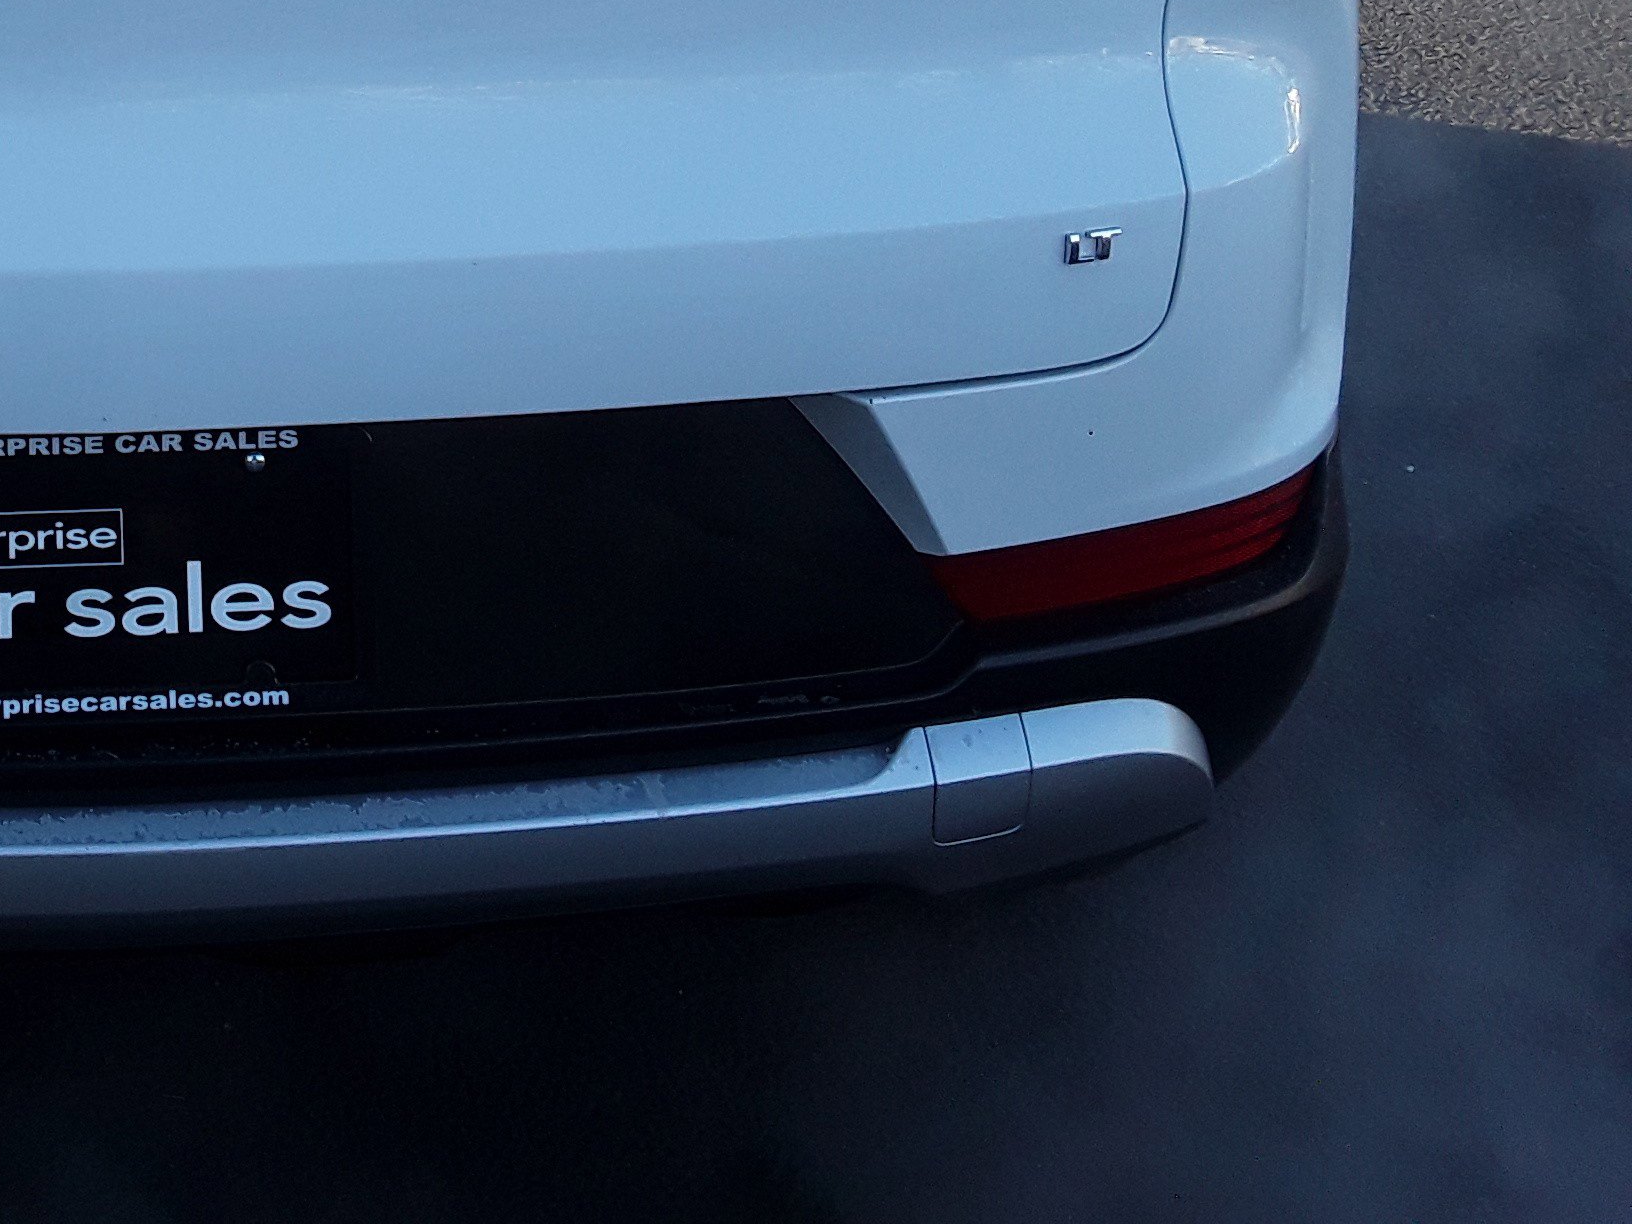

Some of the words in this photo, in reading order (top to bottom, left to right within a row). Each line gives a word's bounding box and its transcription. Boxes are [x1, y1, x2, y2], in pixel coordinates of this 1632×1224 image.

[1064, 226, 1123, 265] LT
[114, 433, 183, 454] CAR
[193, 429, 299, 451] SALES
[63, 560, 333, 637] sales
